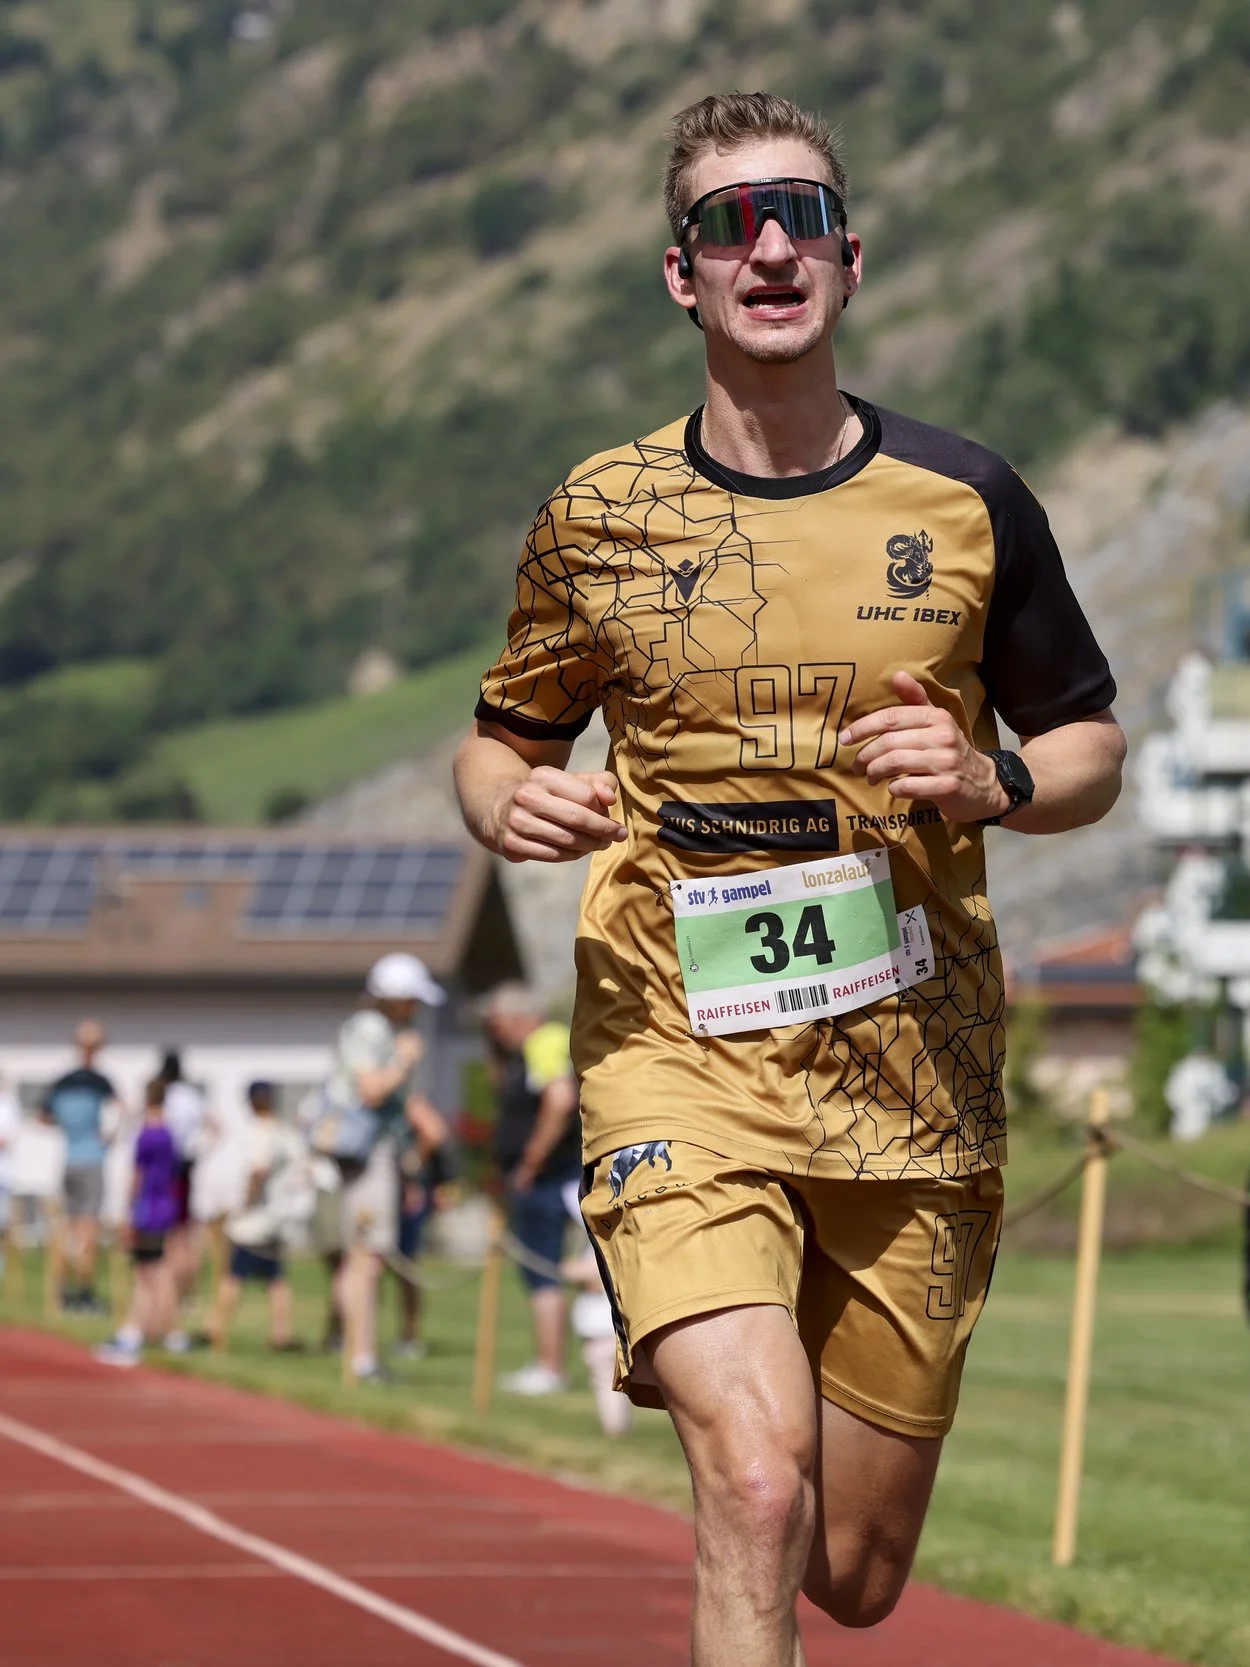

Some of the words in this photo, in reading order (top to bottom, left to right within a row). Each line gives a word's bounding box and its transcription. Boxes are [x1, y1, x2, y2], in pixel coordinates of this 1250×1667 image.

[857, 605, 907, 621] UHC
[913, 608, 961, 626] IBEX
[734, 662, 856, 771] 97
[701, 818, 800, 835] SCHNIDRIG
[806, 817, 830, 833] AG
[802, 858, 871, 888] lonzalauf
[688, 889, 705, 905] stv
[722, 880, 772, 904] gampel
[744, 904, 836, 974] 34
[915, 958, 928, 976] 34
[833, 965, 900, 999] RAIFFEISEN
[697, 999, 771, 1021] RAIFFEISEN
[926, 1210, 992, 1320] 97
